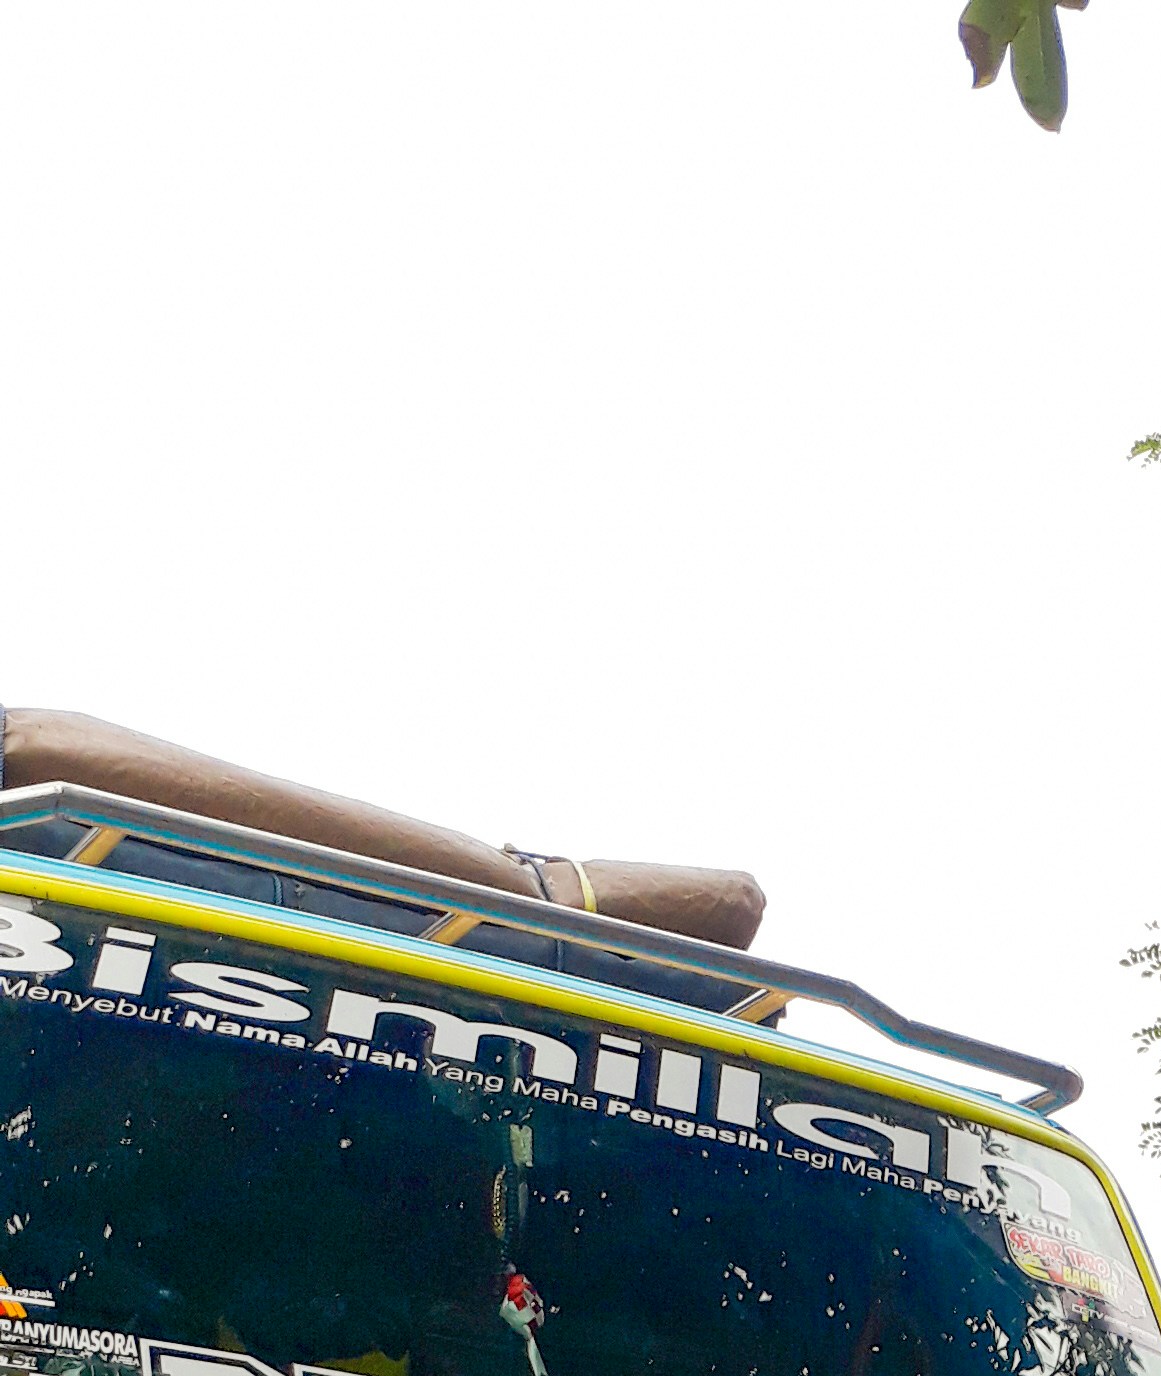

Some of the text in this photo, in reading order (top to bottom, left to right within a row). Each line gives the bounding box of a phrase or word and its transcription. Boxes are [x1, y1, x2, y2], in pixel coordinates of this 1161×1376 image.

[0, 976, 1083, 1243] Menyebut Nama Allah Yang Maha Pengasih Lagi Maha Penyayang
[1062, 1265, 1119, 1302] BANGKIT
